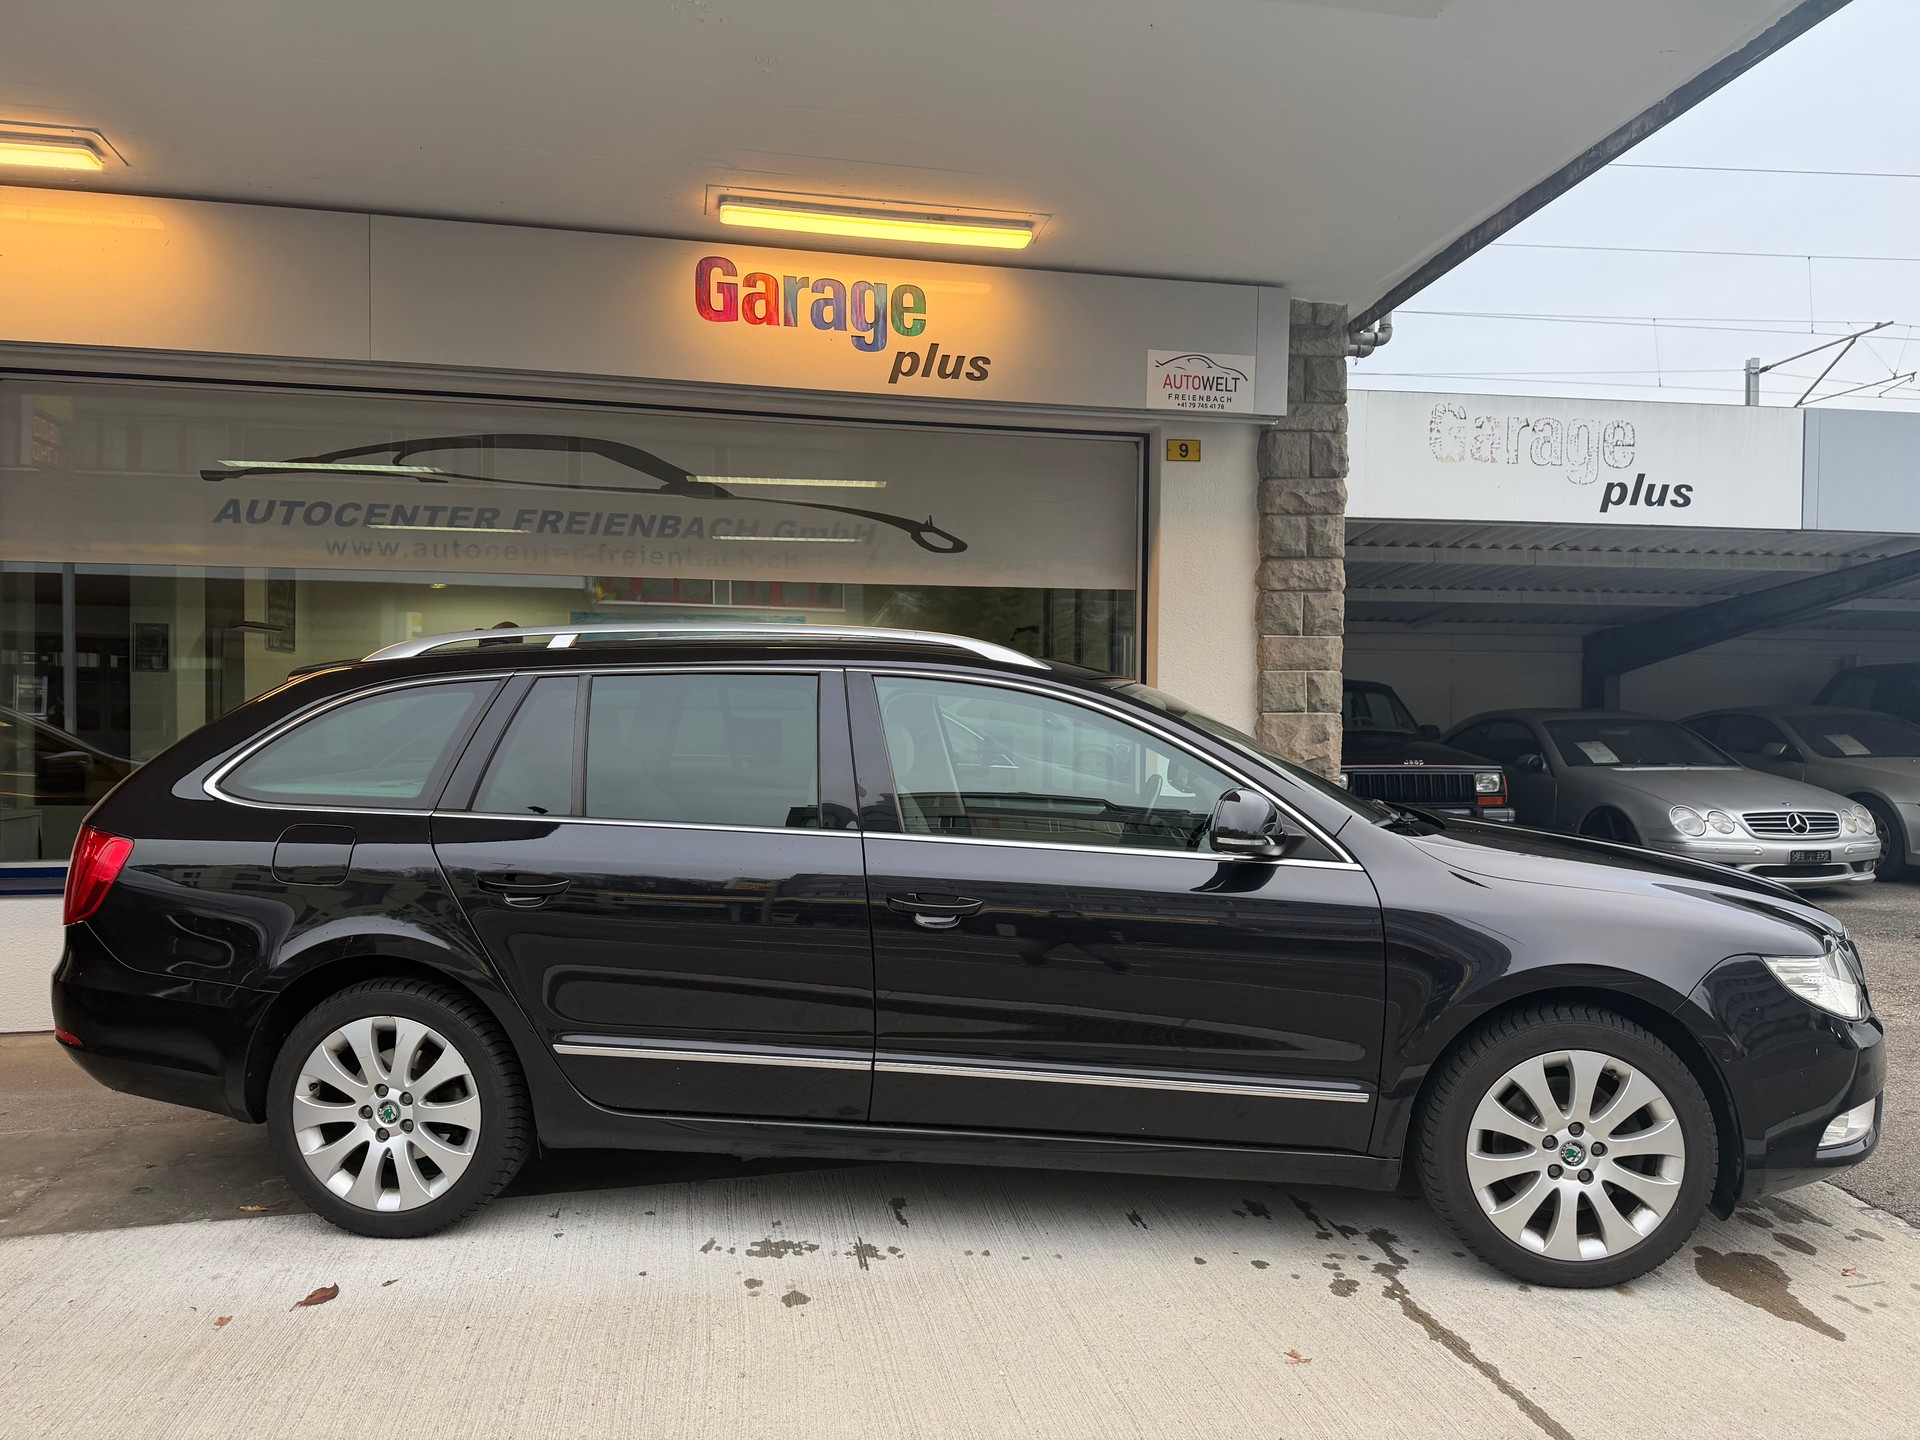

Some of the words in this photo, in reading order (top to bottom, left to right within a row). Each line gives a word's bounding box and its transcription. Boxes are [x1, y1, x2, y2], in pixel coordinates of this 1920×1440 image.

[695, 256, 927, 352] Garage
[888, 343, 992, 384] plus
[1162, 373, 1241, 393] AUTOWELT
[1167, 393, 1232, 403] FREIENBACH
[1179, 443, 1189, 458] 9
[1429, 402, 1636, 485] Garage
[1599, 473, 1694, 512] plus
[212, 498, 502, 530] AUTOCENTER
[512, 508, 760, 540] FREIENBACH
[773, 519, 876, 546] GmbH
